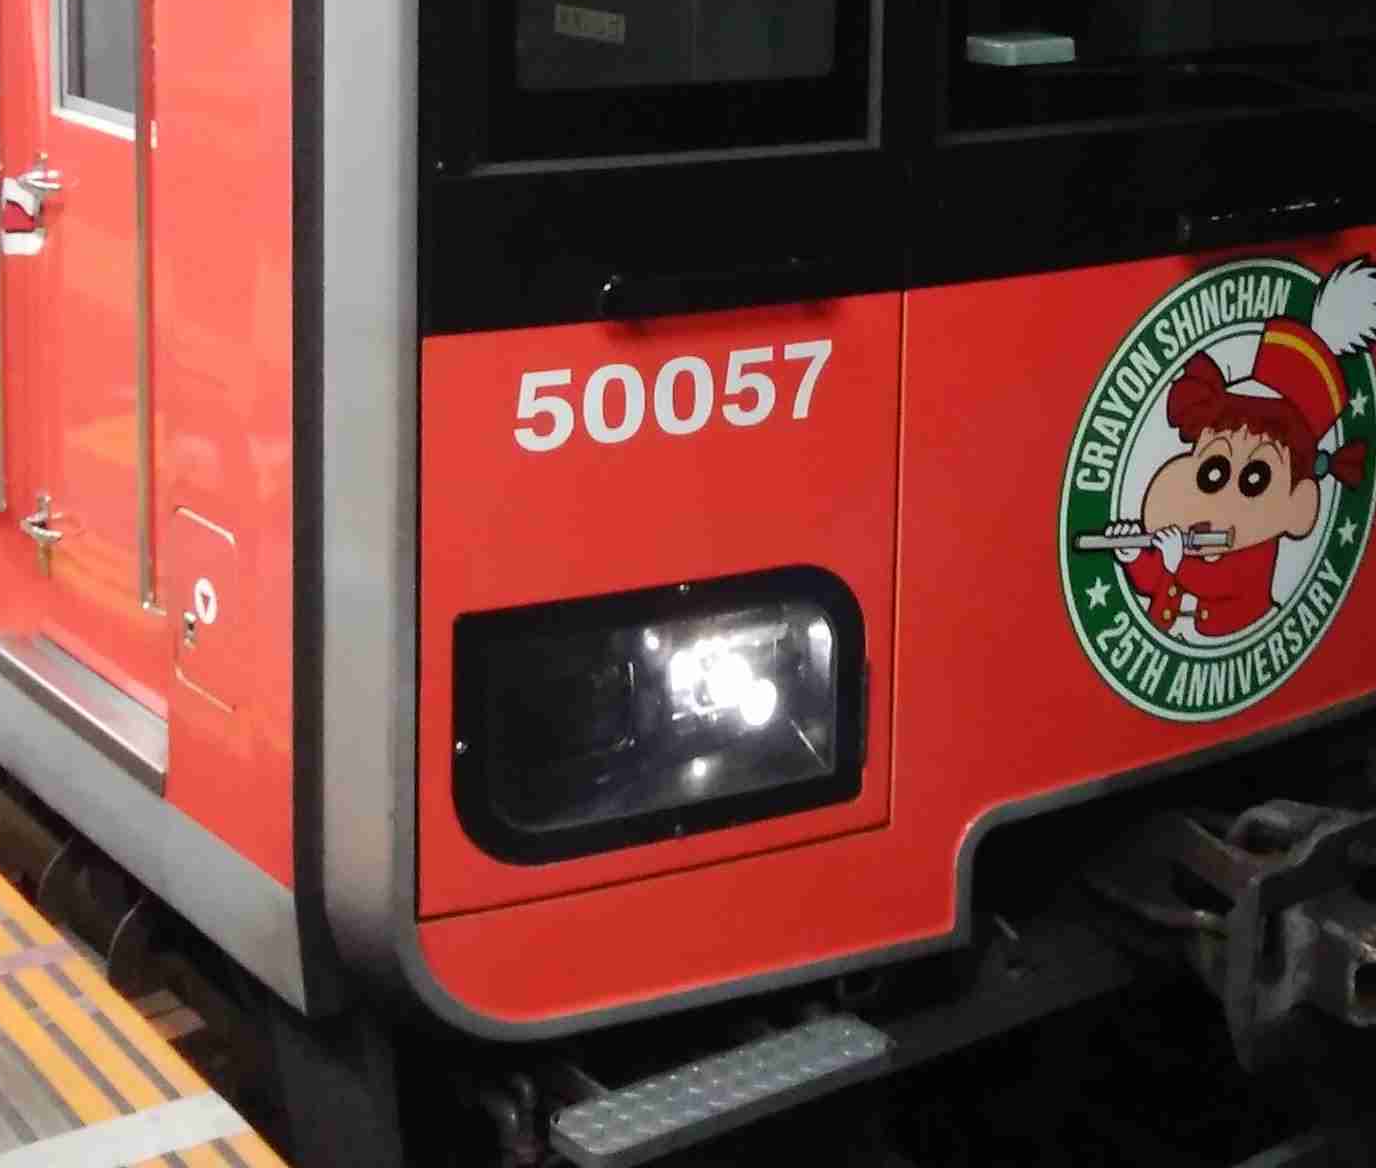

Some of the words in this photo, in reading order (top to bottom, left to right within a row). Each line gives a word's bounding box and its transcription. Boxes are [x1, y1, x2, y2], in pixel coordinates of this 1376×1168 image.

[513, 338, 833, 453] 50057
[1075, 351, 1161, 493] CRAYON
[1157, 274, 1293, 359] SHINCHAN
[1094, 611, 1170, 697] 25TH
[1164, 558, 1346, 708] ANNIVERSARY
